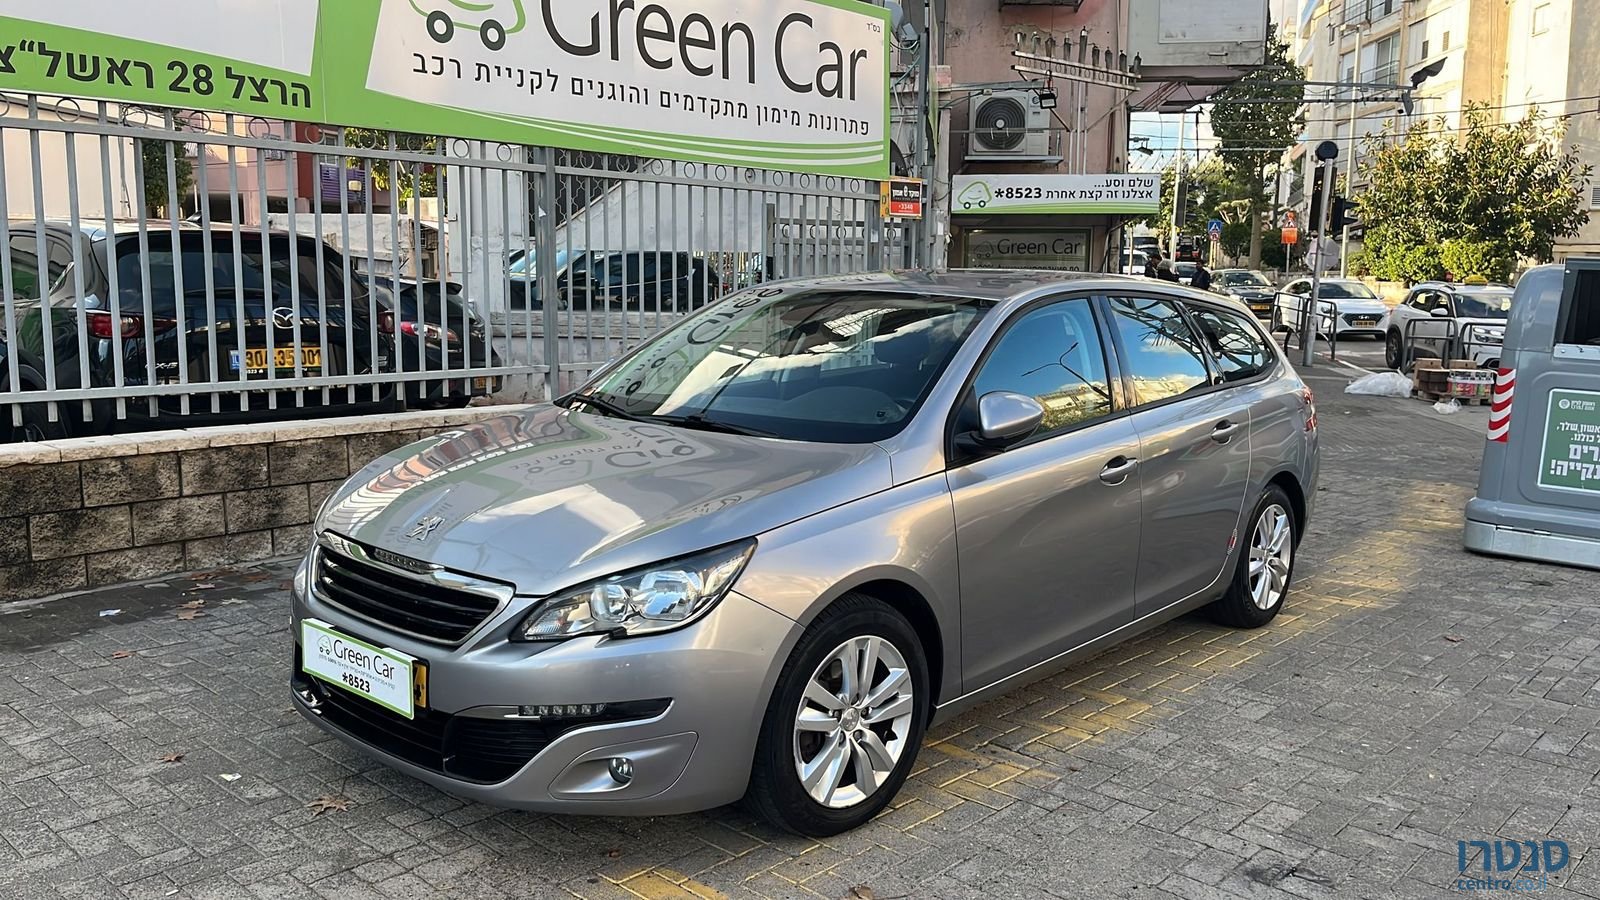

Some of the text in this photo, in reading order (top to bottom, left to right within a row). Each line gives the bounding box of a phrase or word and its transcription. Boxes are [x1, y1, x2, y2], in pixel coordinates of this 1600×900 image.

[541, 0, 867, 101] Green Car
[168, 60, 214, 95] 28
[225, 66, 312, 108] הרצל
[413, 52, 869, 136] פתרונות מימון מתקדמים והוגנים לקניית רכב
[1094, 178, 1154, 188] שלם וסע...
[1045, 189, 1076, 199] אחרת
[1079, 189, 1103, 200] קצת
[1106, 189, 1118, 199] זה
[1122, 189, 1153, 199] אצלנו
[997, 239, 1081, 255] Green Car
[333, 639, 371, 671] Green
[373, 654, 395, 680] Car
